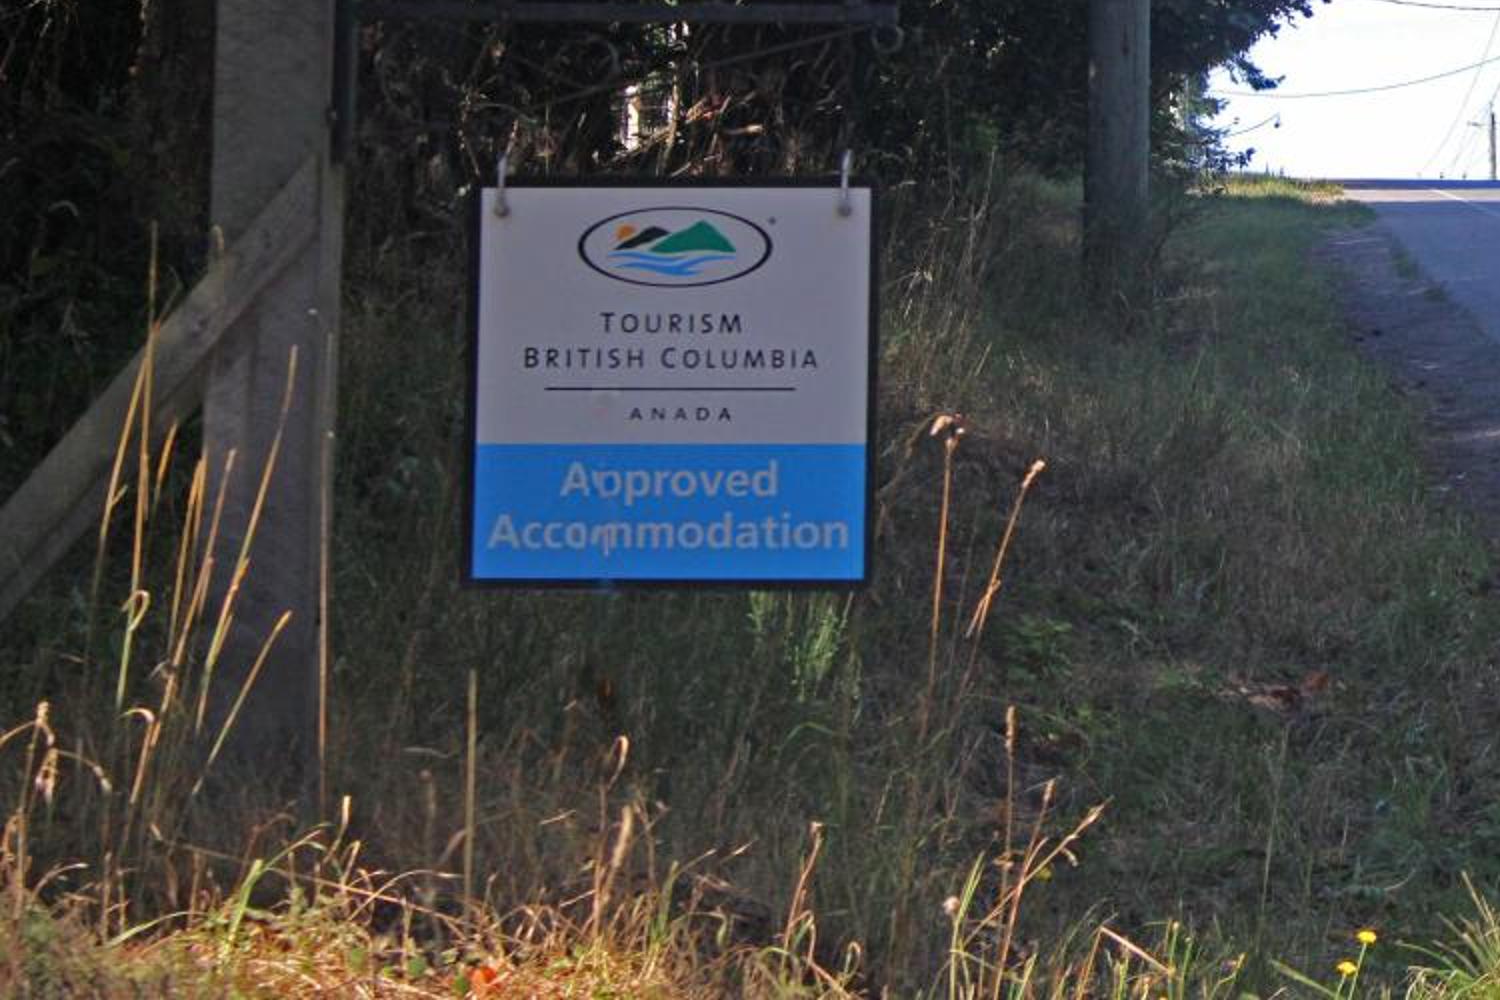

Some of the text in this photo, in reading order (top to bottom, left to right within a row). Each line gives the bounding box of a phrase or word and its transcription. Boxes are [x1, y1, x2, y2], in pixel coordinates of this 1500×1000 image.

[600, 312, 743, 334] TOURISM
[523, 347, 818, 369] BRITISH COLUMBIA
[487, 512, 849, 553] Accommodation
